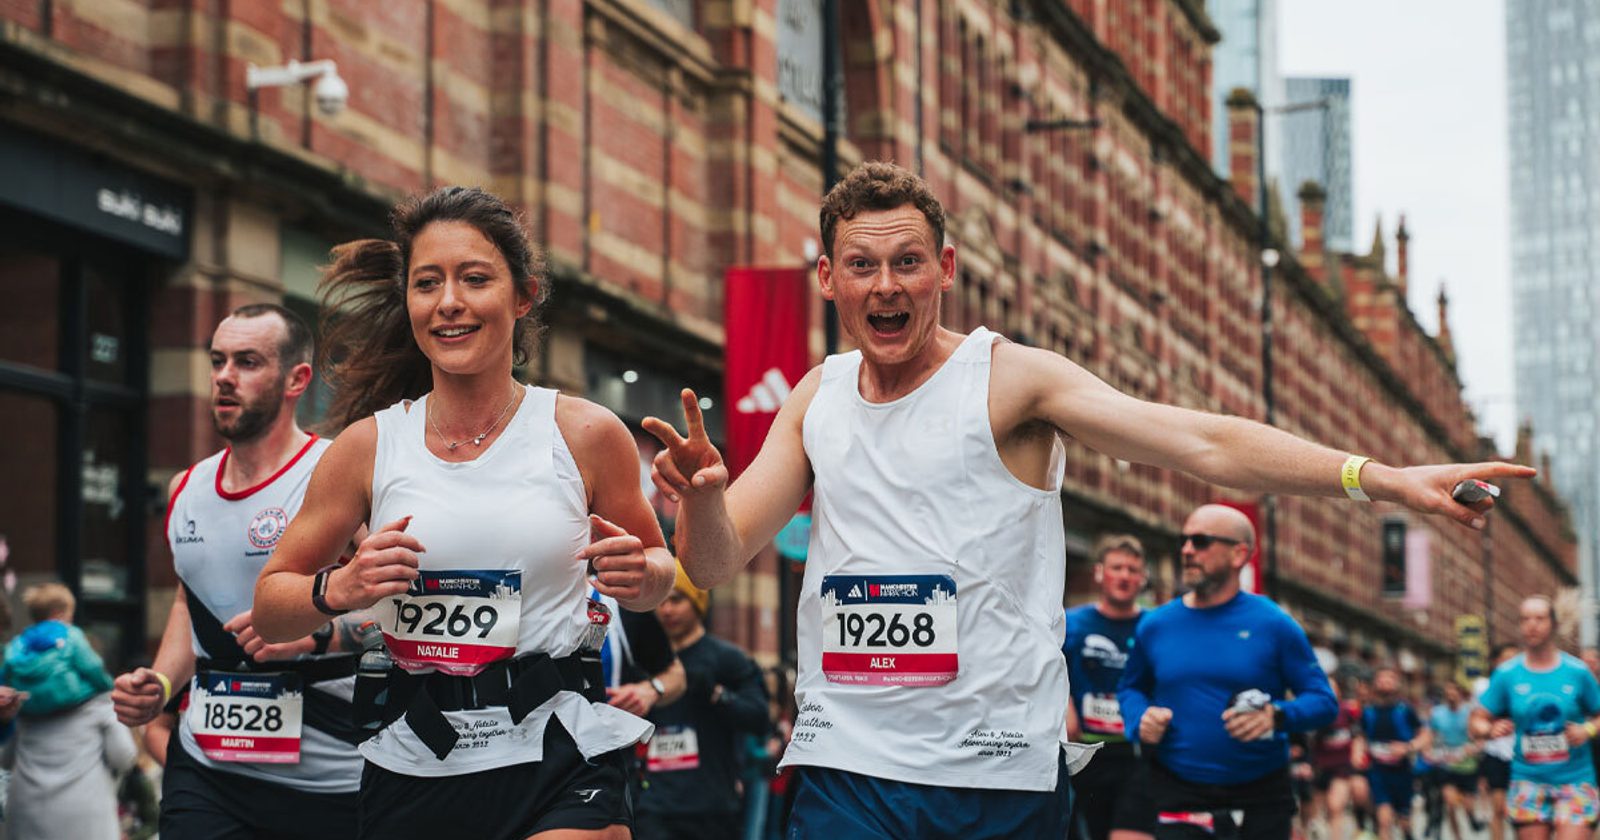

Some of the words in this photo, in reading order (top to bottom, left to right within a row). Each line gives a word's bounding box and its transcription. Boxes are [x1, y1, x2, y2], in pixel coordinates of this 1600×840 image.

[880, 589, 919, 597] MARATHON
[392, 598, 498, 639] 19269
[836, 612, 936, 648] 19268
[417, 645, 459, 659] NATALIE
[869, 657, 896, 669] ALEX
[205, 702, 283, 732] 18528
[220, 737, 255, 748] MARTIN
